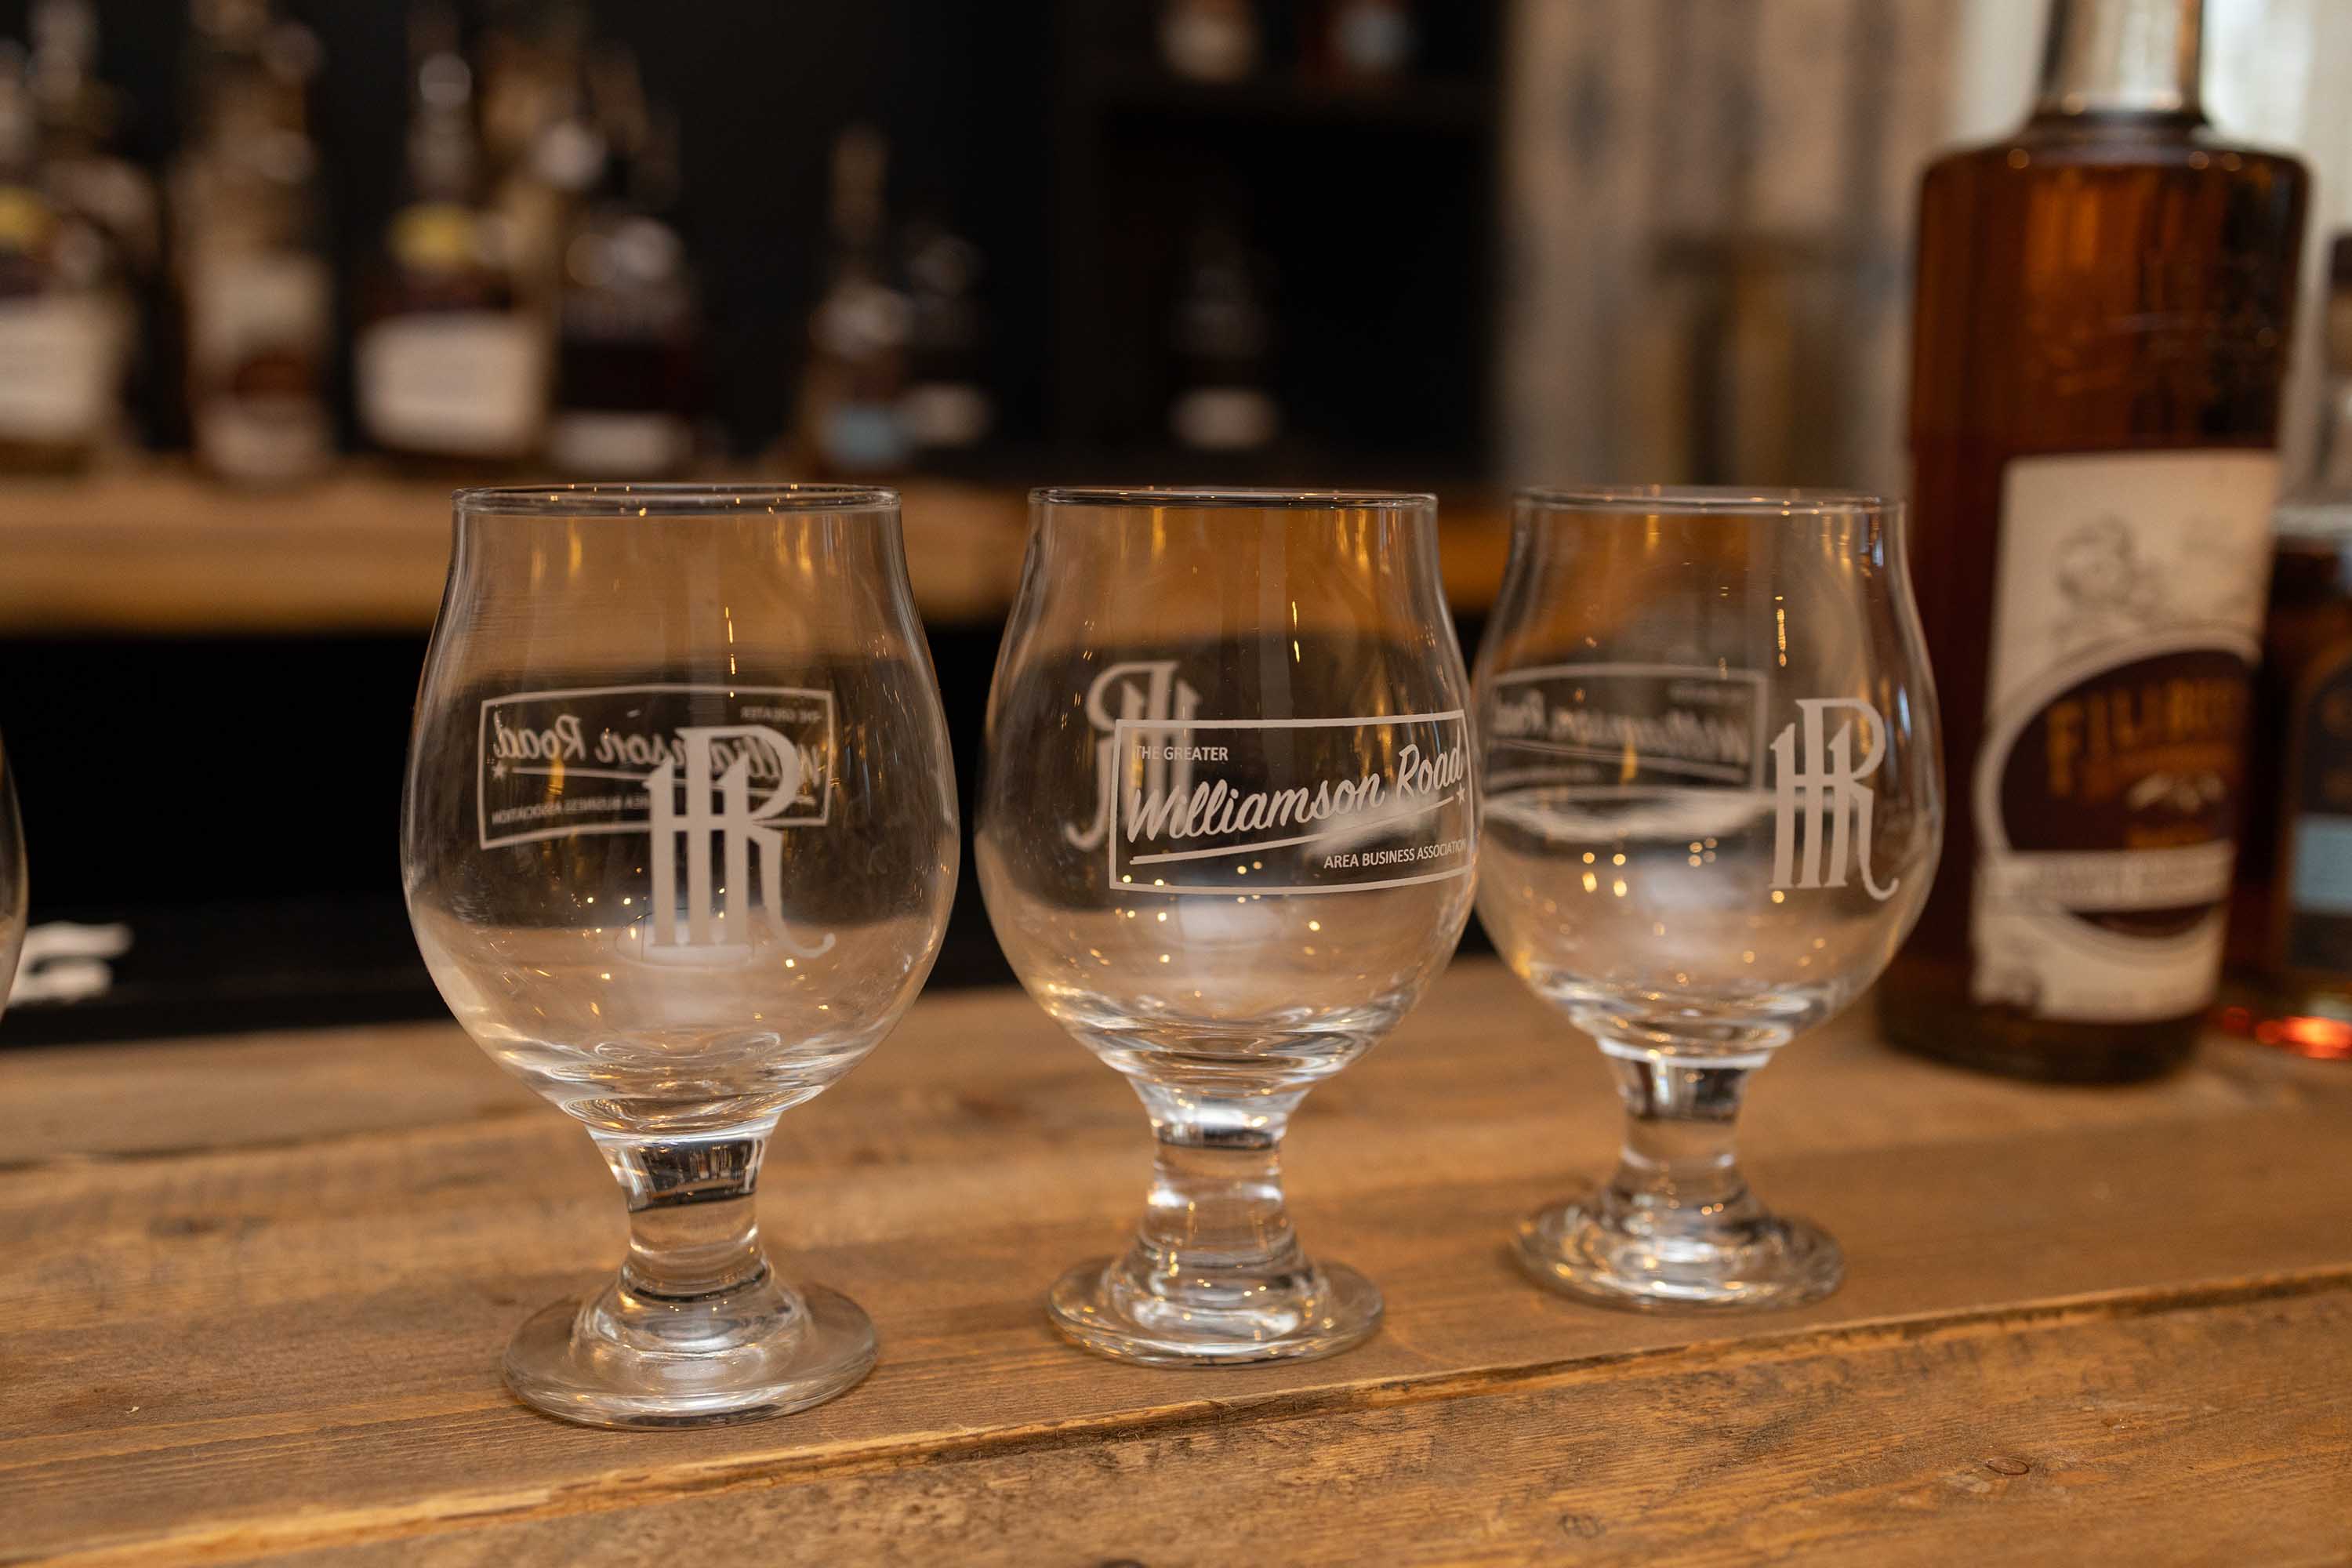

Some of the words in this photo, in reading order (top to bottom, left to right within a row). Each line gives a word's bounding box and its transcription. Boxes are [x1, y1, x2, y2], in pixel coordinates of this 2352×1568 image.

[1136, 746, 1162, 760] THE
[1163, 746, 1229, 761] GREATER
[1127, 772, 1386, 843] Williamson
[1396, 724, 1463, 798] Road
[1323, 854, 1359, 869] AREA
[1362, 848, 1415, 867] BUSINESS
[1417, 838, 1468, 861] ASSOCIATION
